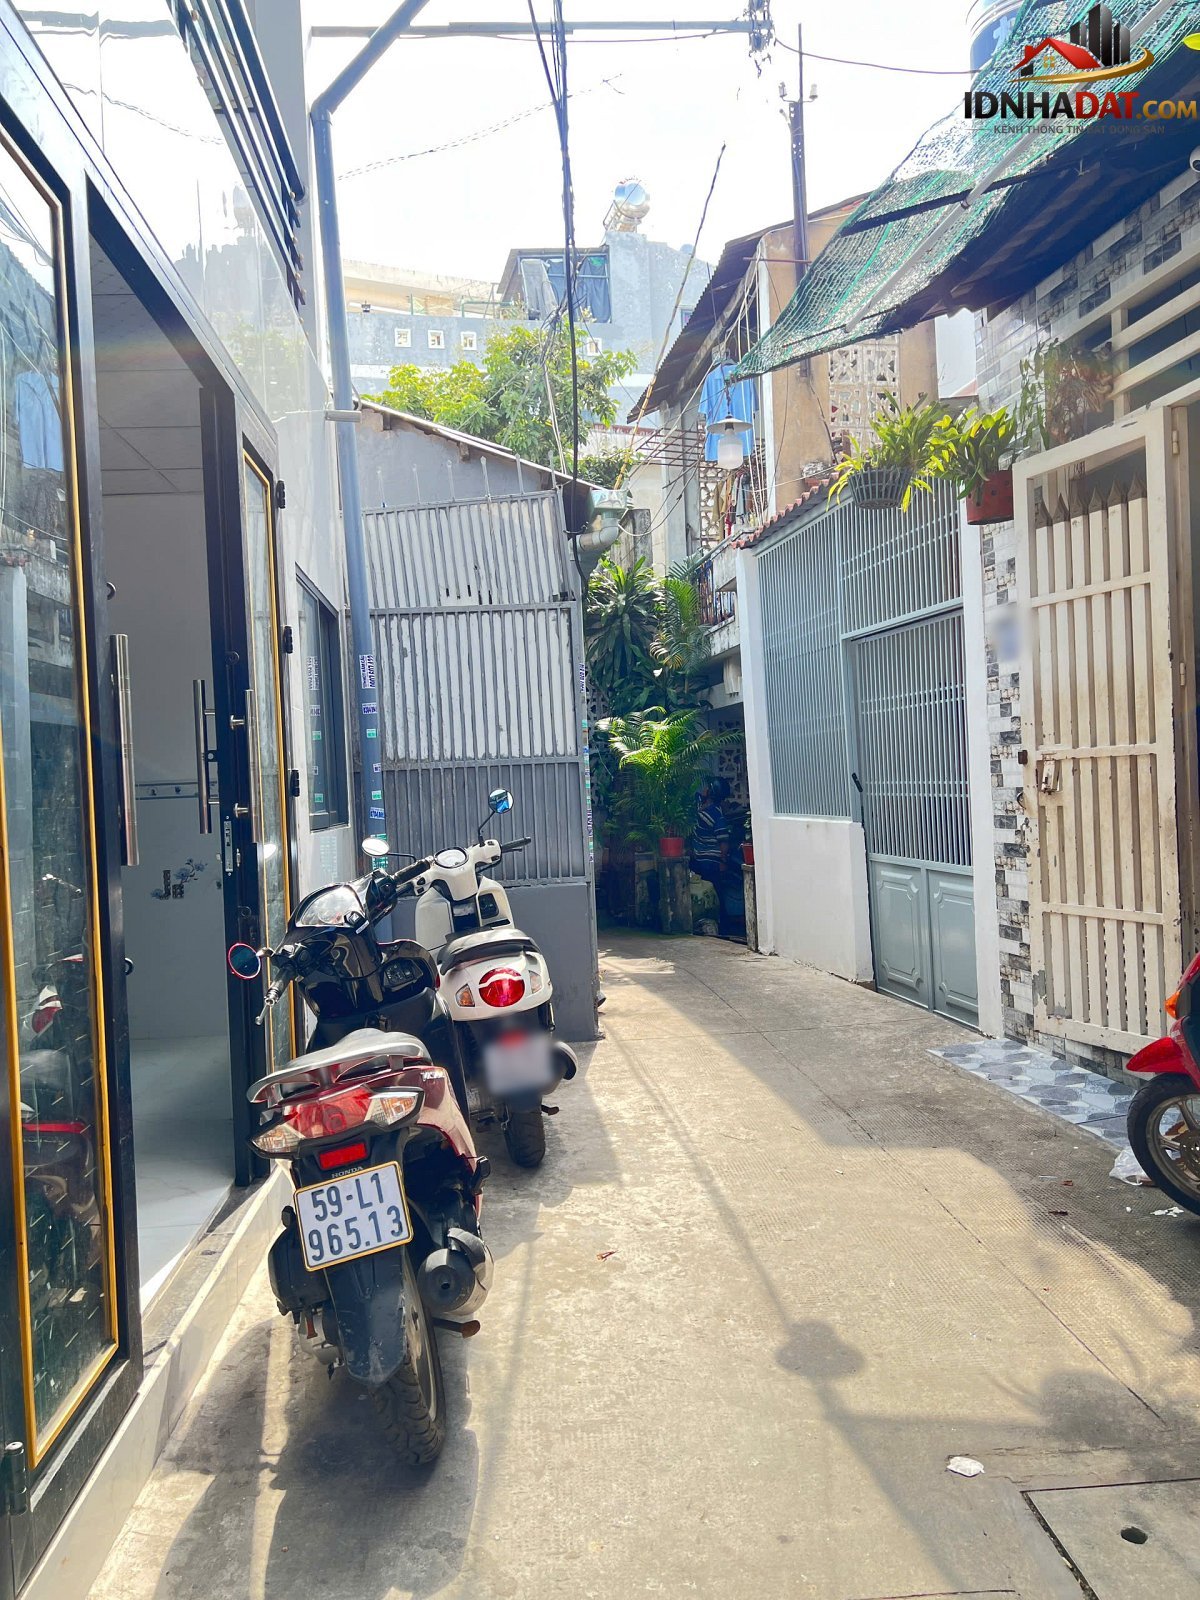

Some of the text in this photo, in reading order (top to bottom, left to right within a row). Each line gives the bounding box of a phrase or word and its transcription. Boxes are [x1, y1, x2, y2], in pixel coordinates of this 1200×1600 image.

[331, 1166, 364, 1179] HONDA
[311, 1173, 385, 1222] 59-L1
[308, 1205, 404, 1262] 965.13
